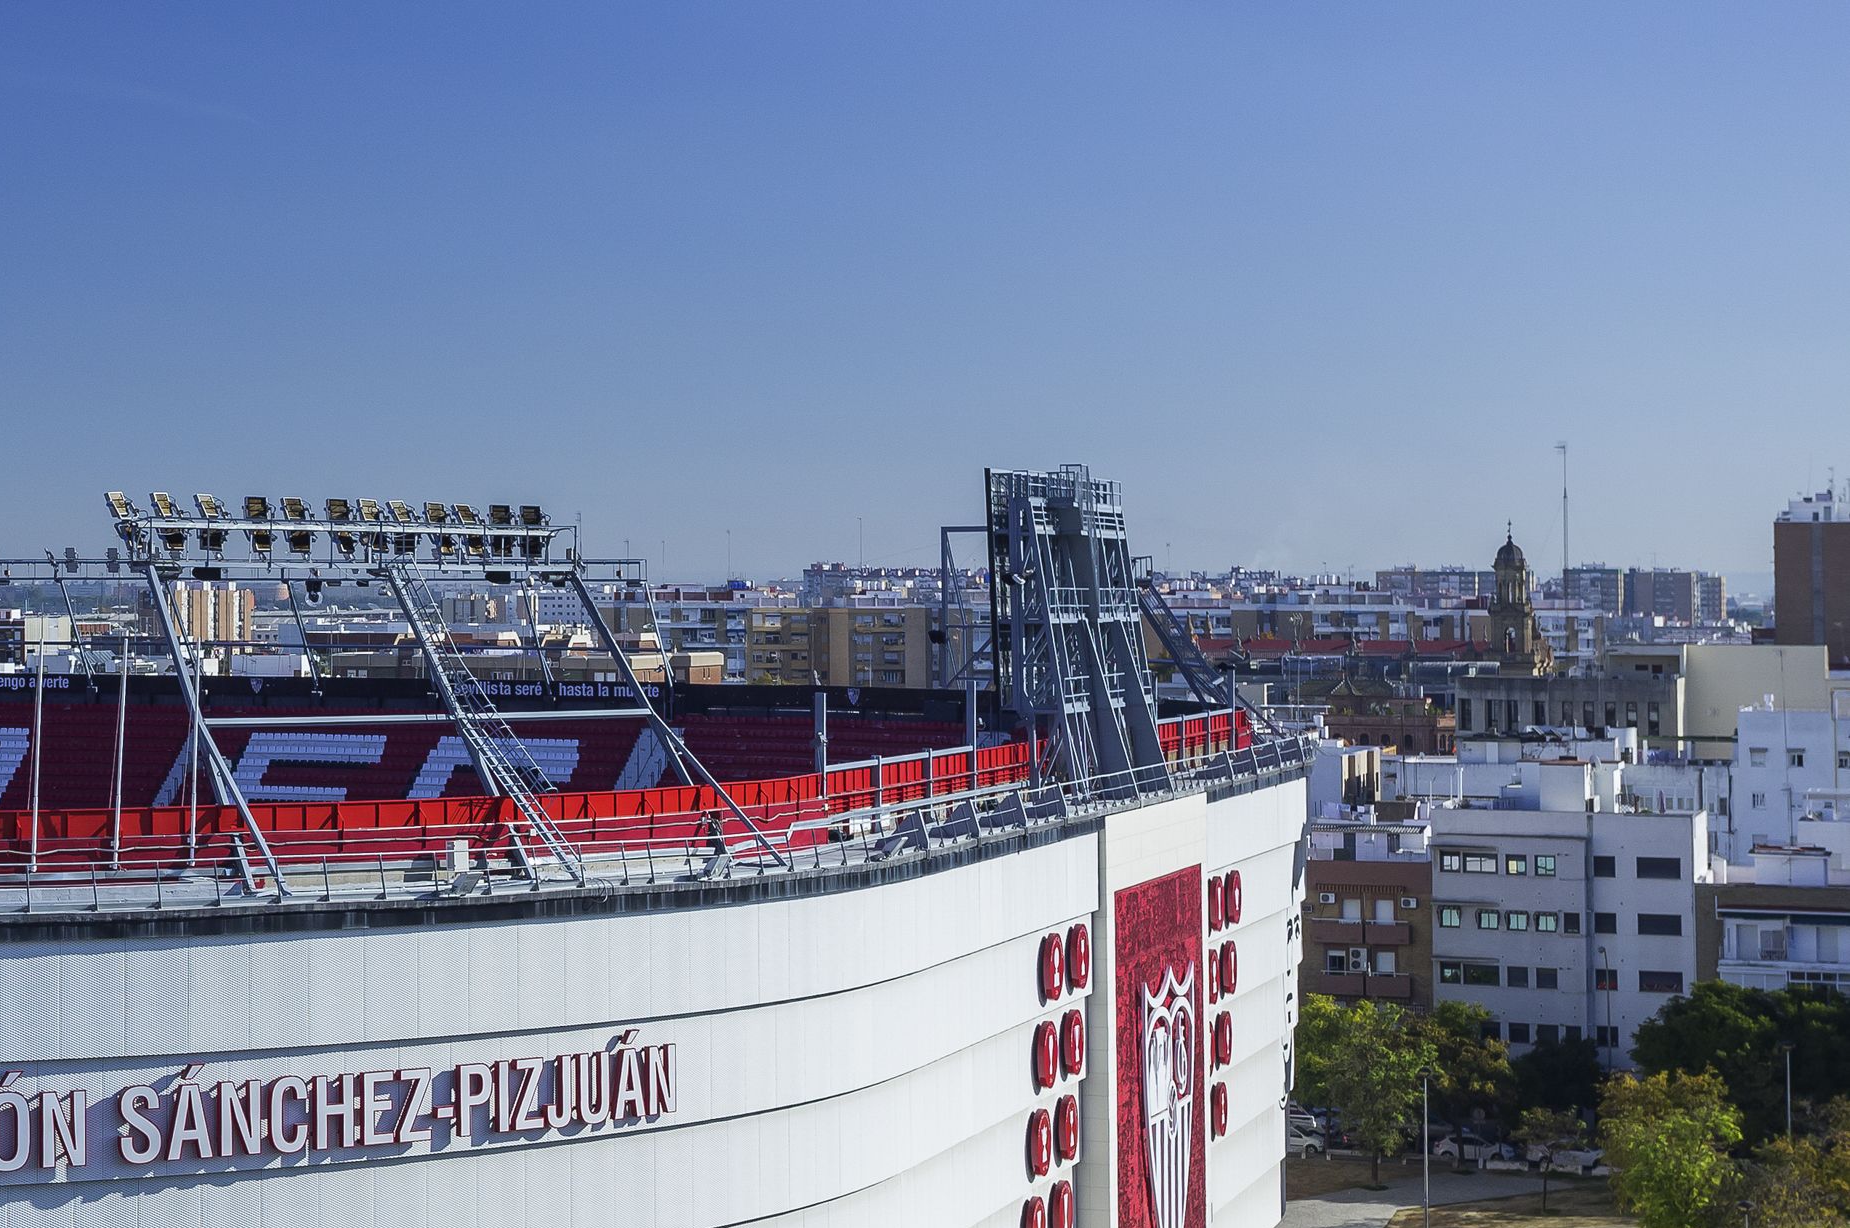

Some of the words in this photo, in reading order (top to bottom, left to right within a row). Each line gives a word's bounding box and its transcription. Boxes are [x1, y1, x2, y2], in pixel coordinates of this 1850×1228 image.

[515, 681, 542, 696] seré
[559, 683, 594, 697] hasta
[598, 683, 609, 697] la
[614, 685, 659, 698] murte
[117, 1028, 677, 1165] SÁNCHEZ-PIZJUÁN
